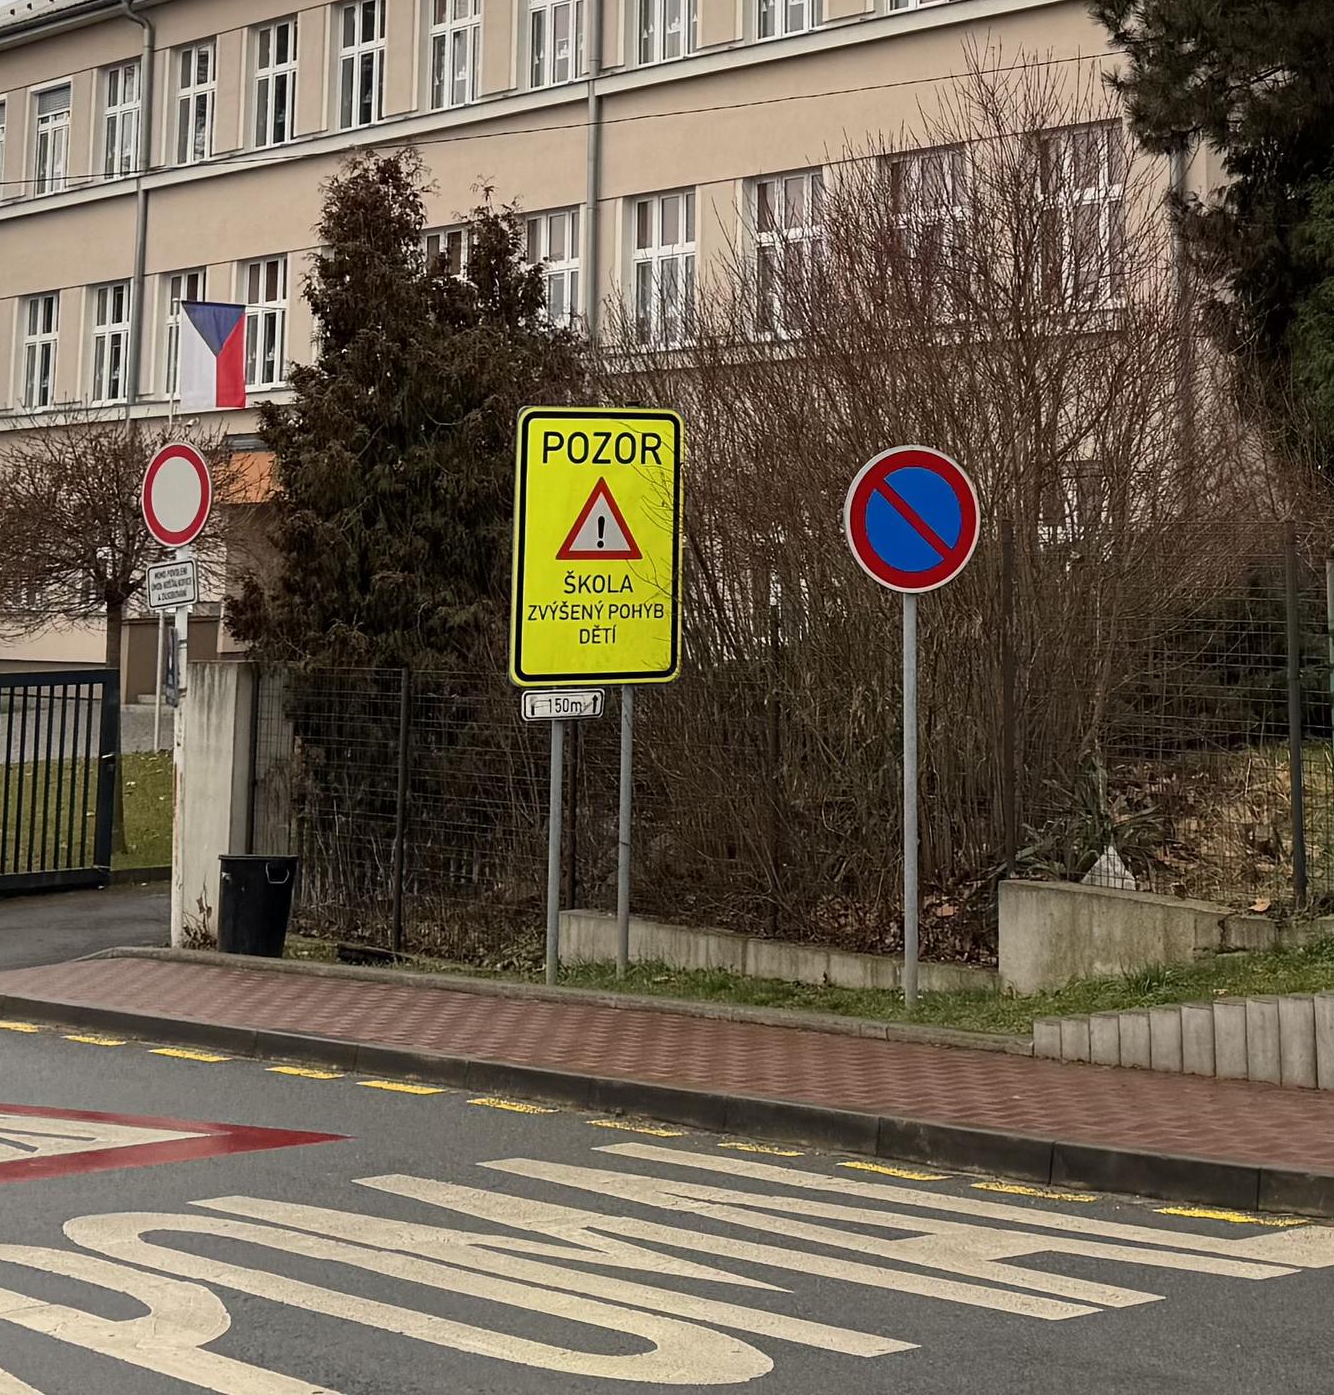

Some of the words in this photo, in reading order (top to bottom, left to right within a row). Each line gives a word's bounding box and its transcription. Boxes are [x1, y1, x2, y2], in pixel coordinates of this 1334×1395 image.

[542, 431, 663, 465] POZOR
[563, 570, 634, 594] ŠKOLA
[527, 600, 604, 621] ZVÝŠENÝ
[608, 603, 665, 620] POHYB
[579, 624, 617, 644] DĚTÍ
[548, 698, 583, 714] 150m
